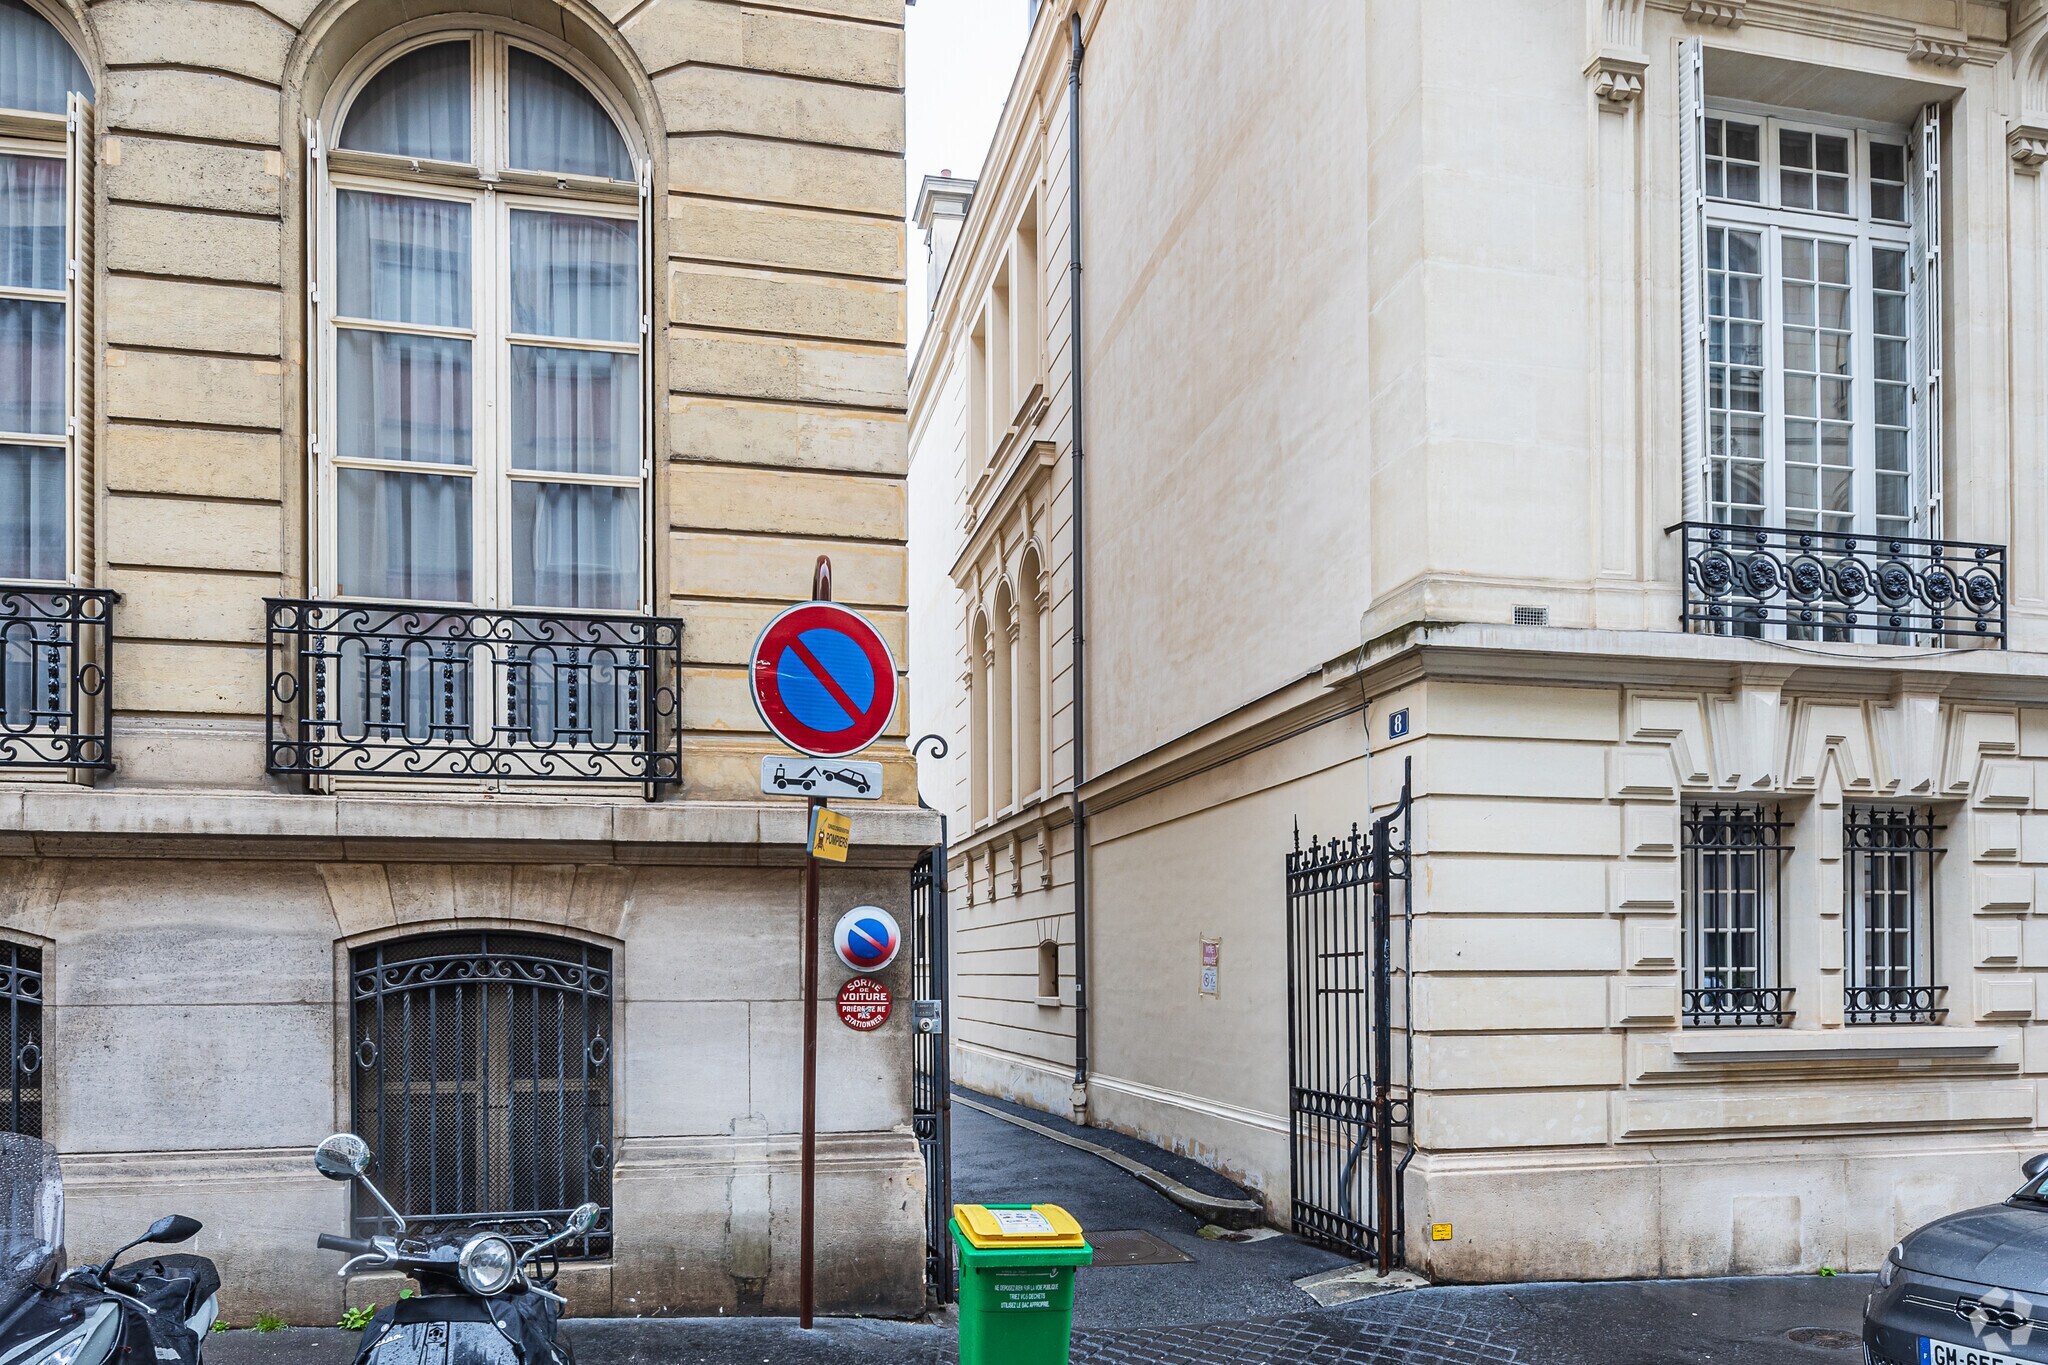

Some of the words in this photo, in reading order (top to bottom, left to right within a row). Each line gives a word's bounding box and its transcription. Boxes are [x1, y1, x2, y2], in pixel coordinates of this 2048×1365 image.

[1394, 714, 1402, 733] 8
[826, 832, 848, 849] POMPIERS
[847, 979, 882, 992] SORTIE
[842, 993, 887, 1001] VOITURE
[844, 1014, 883, 1028] STATIONNER
